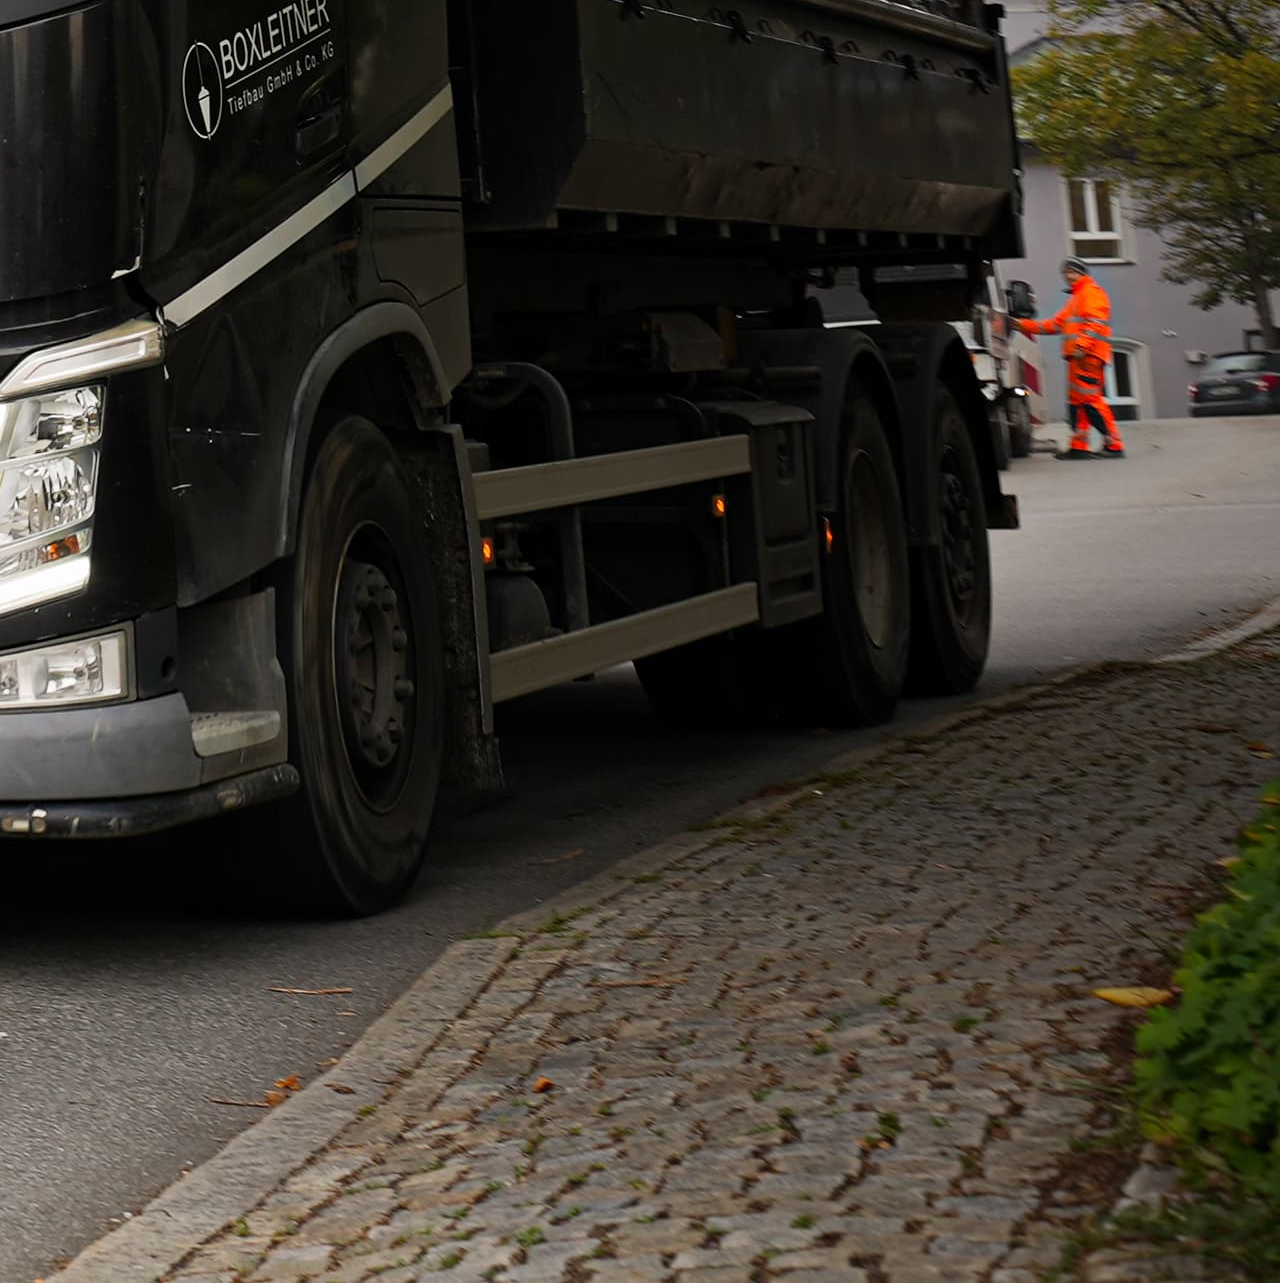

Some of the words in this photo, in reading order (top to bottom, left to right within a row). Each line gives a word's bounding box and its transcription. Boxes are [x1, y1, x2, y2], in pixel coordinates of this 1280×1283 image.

[227, 84, 264, 115] Tiefbau
[266, 64, 294, 93] GmbH
[296, 59, 303, 77] &
[304, 54, 320, 71] Co.
[321, 40, 335, 62] KG
